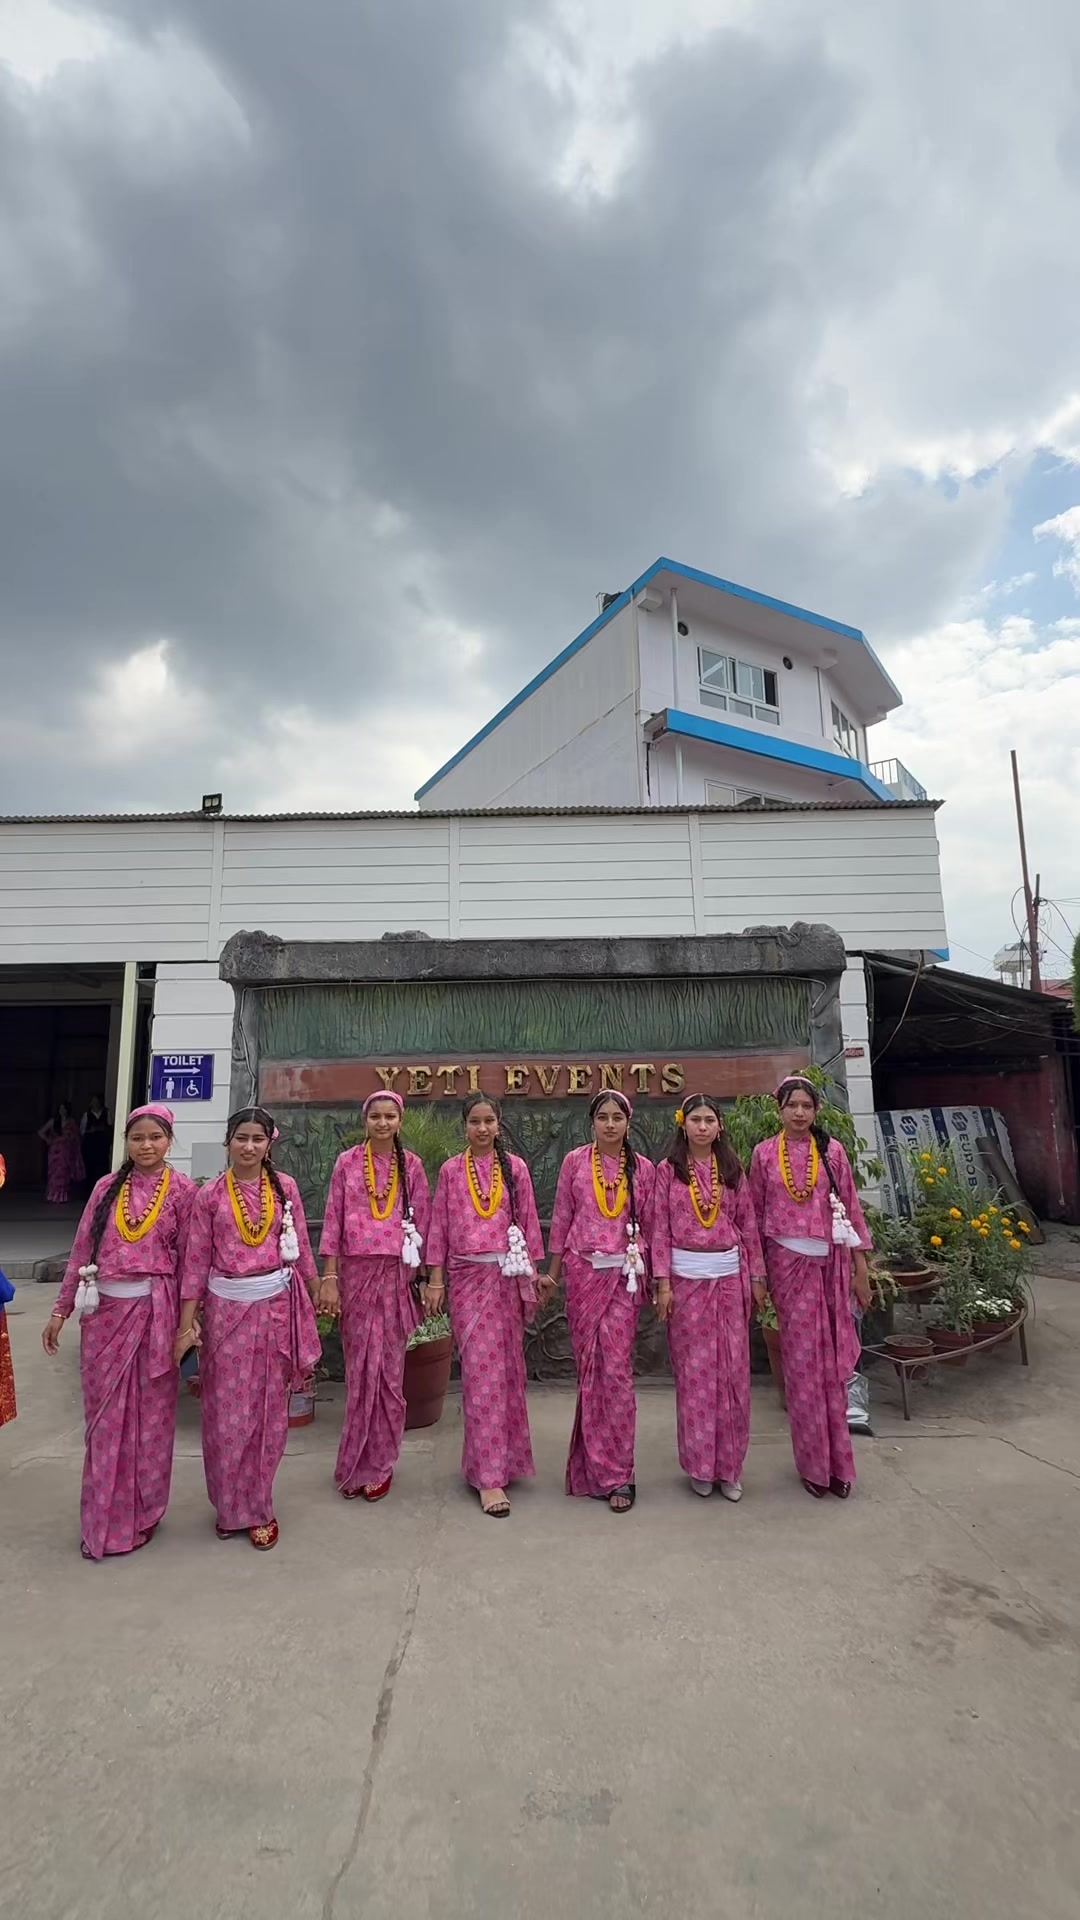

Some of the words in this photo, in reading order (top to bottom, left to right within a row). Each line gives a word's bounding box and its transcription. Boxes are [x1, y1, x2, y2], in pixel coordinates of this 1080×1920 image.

[162, 1055, 204, 1066] TOILET
[375, 1064, 481, 1095] YETI
[504, 1063, 686, 1095] EVENTS
